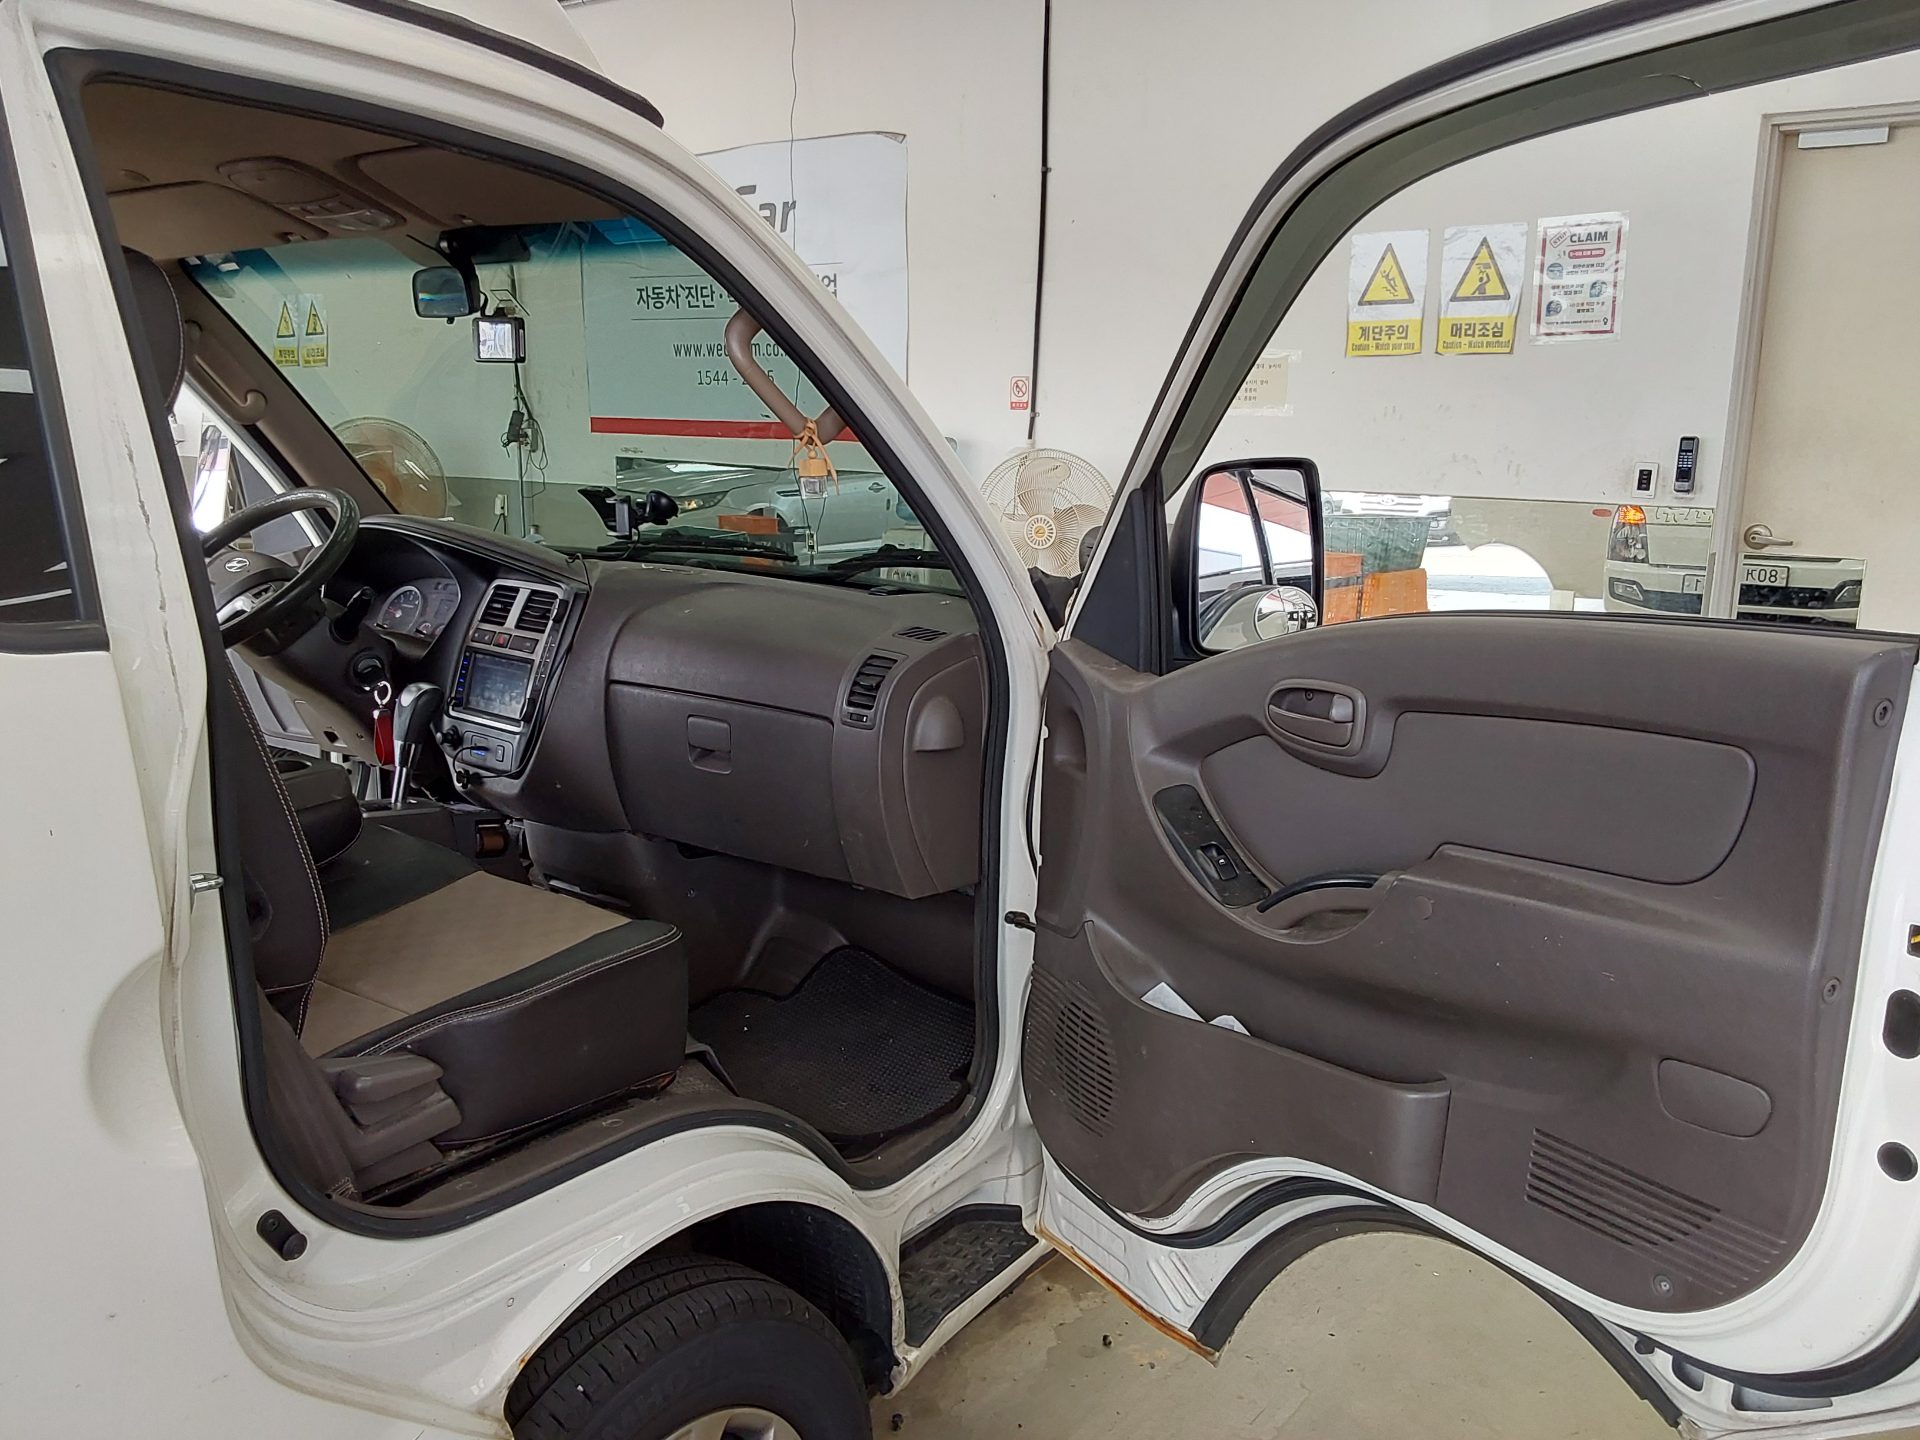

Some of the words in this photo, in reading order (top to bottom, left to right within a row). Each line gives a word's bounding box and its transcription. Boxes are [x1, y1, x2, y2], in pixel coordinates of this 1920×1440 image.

[1570, 231, 1608, 243] CLAIM
[1358, 324, 1409, 342] 계단주의
[1450, 322, 1504, 339] 머리조심
